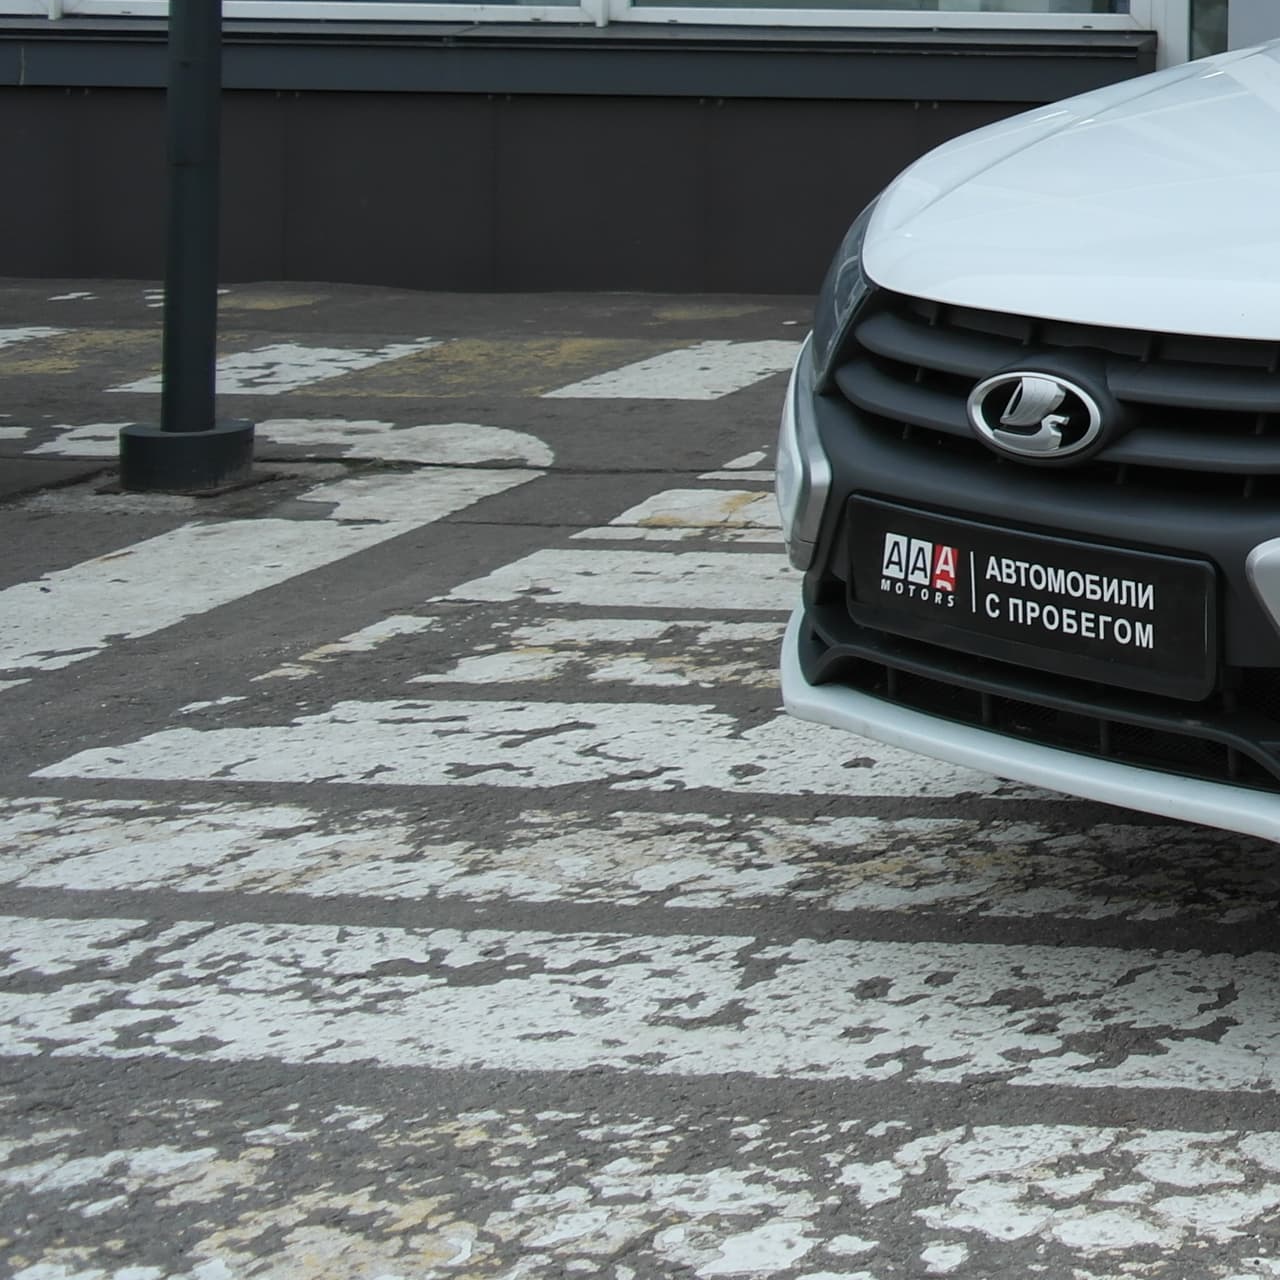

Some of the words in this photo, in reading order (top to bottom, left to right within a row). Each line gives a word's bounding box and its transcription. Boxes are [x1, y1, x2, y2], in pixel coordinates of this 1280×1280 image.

[881, 578, 955, 607] MOTORS
[985, 556, 1155, 610] АВТОМОБИЛИ
[985, 593, 1000, 618] С
[1009, 597, 1154, 649] ПРОБЕГОМ
